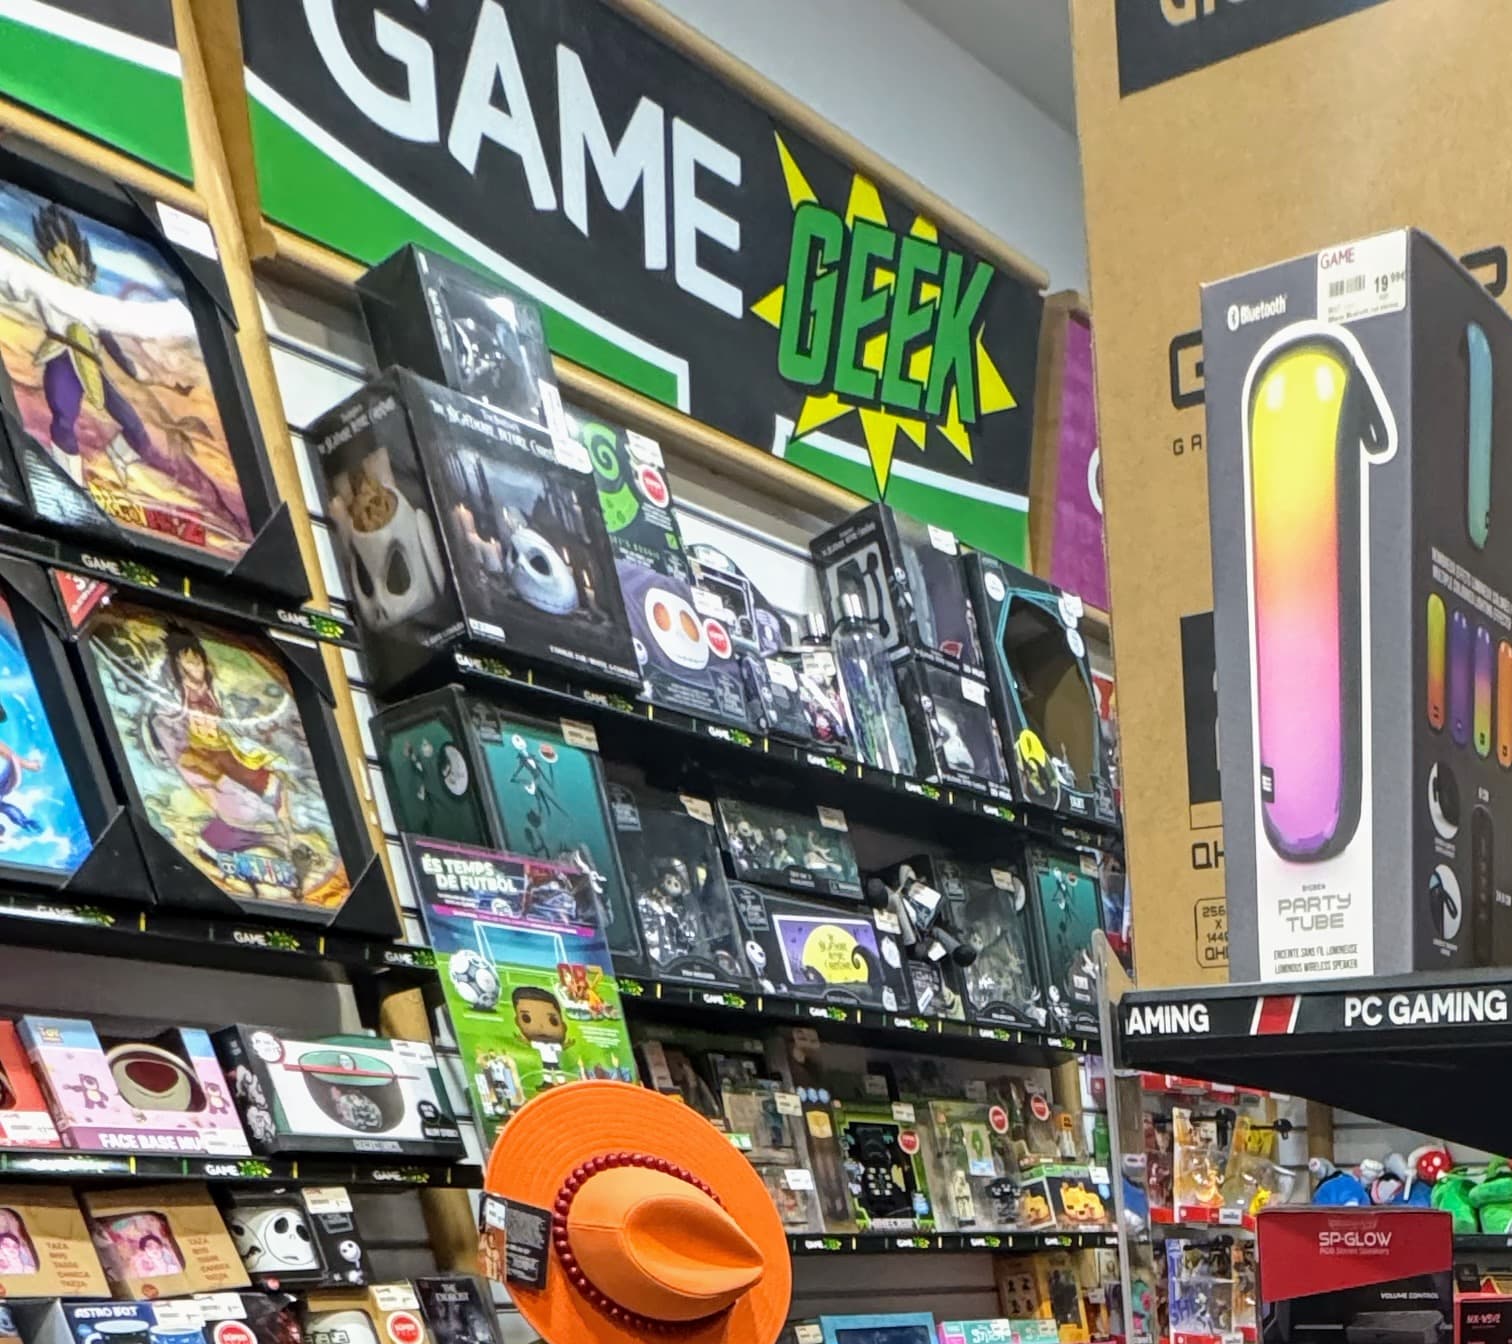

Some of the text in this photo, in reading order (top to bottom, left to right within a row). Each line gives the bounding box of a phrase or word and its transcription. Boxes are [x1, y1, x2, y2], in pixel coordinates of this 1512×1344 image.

[303, 0, 743, 319] GAME
[1320, 248, 1355, 270] GAME
[778, 200, 994, 424] GEEK
[1239, 295, 1287, 325] Bluetooth
[436, 873, 460, 891] DE
[1278, 893, 1351, 915] PARTY
[1286, 913, 1344, 932] TUBE
[233, 931, 267, 946] GAME
[1124, 1003, 1210, 1036] AMING
[1344, 997, 1384, 1028] PC
[1388, 991, 1508, 1026] GAMING
[99, 1132, 175, 1152] FACE BASE
[205, 1163, 240, 1177] GAME
[1319, 1231, 1392, 1248] SP-GLOW
